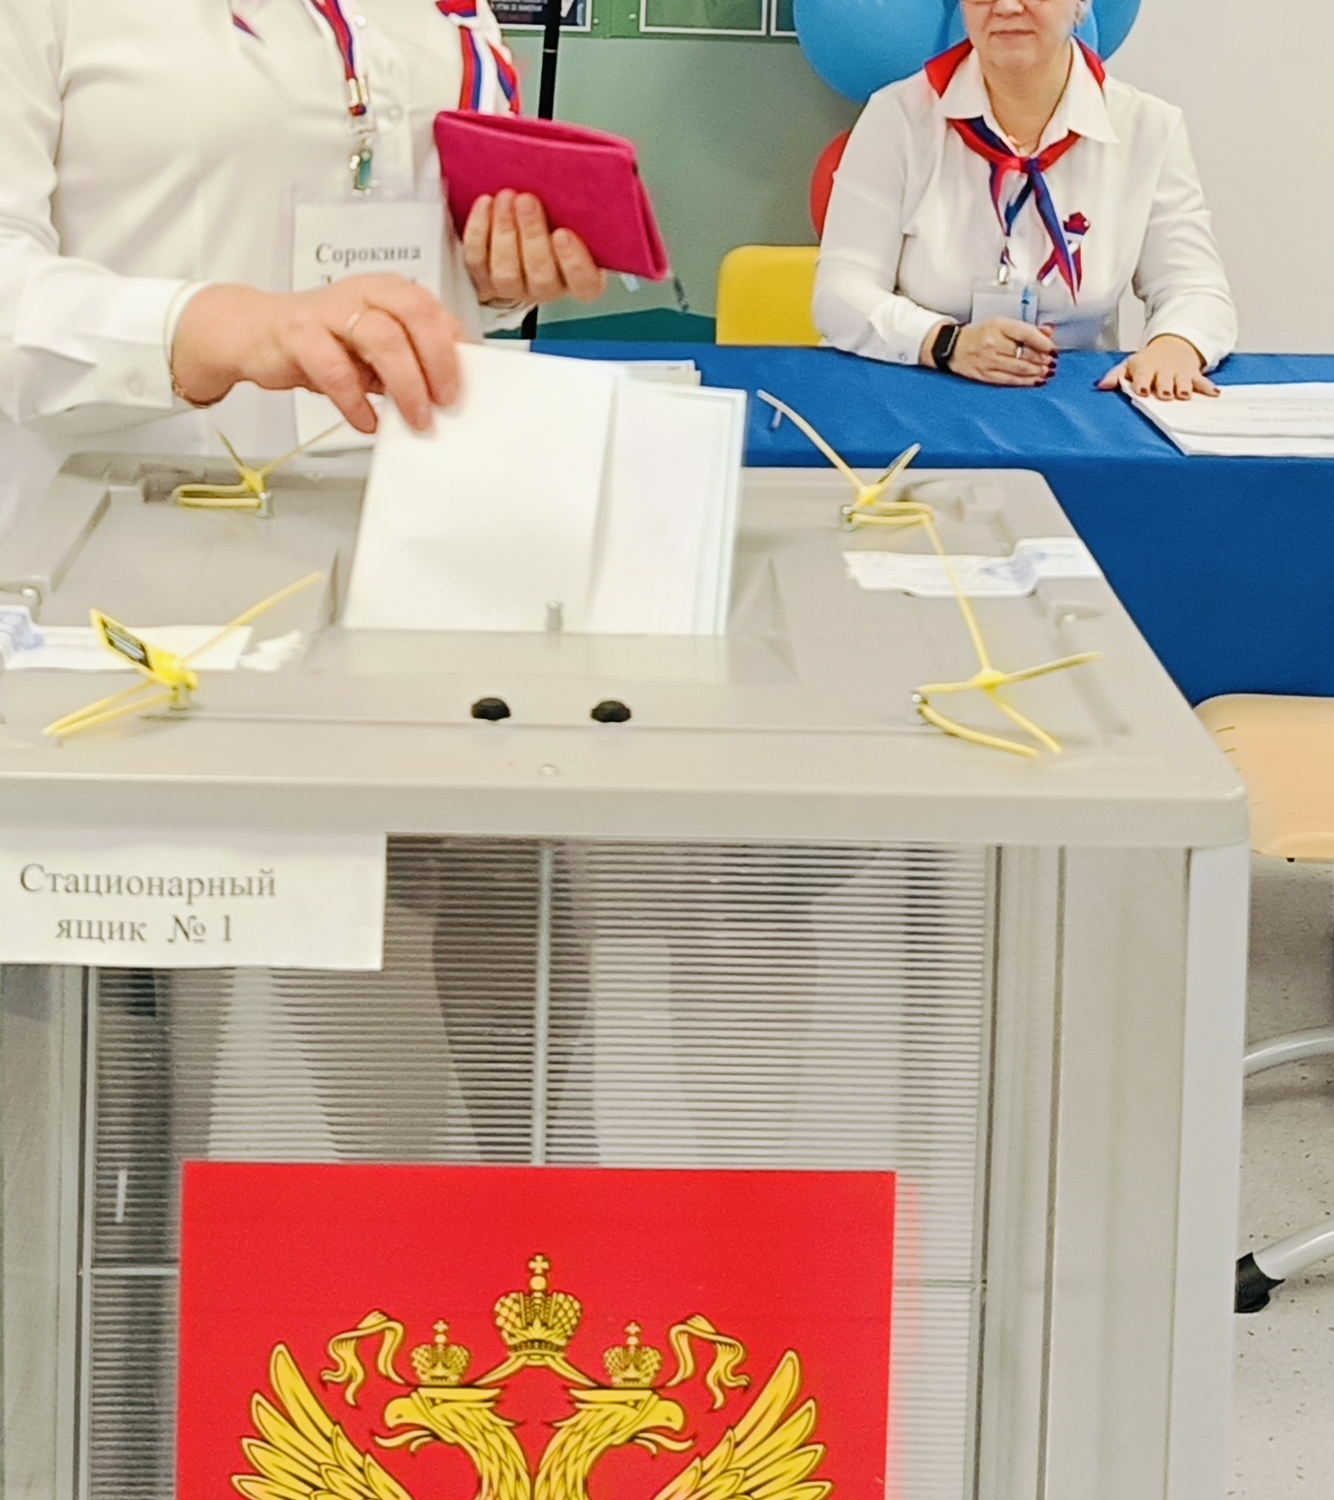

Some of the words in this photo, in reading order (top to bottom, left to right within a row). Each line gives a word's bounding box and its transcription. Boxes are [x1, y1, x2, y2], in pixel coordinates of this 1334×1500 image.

[316, 242, 422, 268] Сорокина
[19, 863, 277, 905] Стационарный
[54, 917, 148, 942] ящик
[167, 914, 207, 943] №
[222, 915, 234, 942] 1
